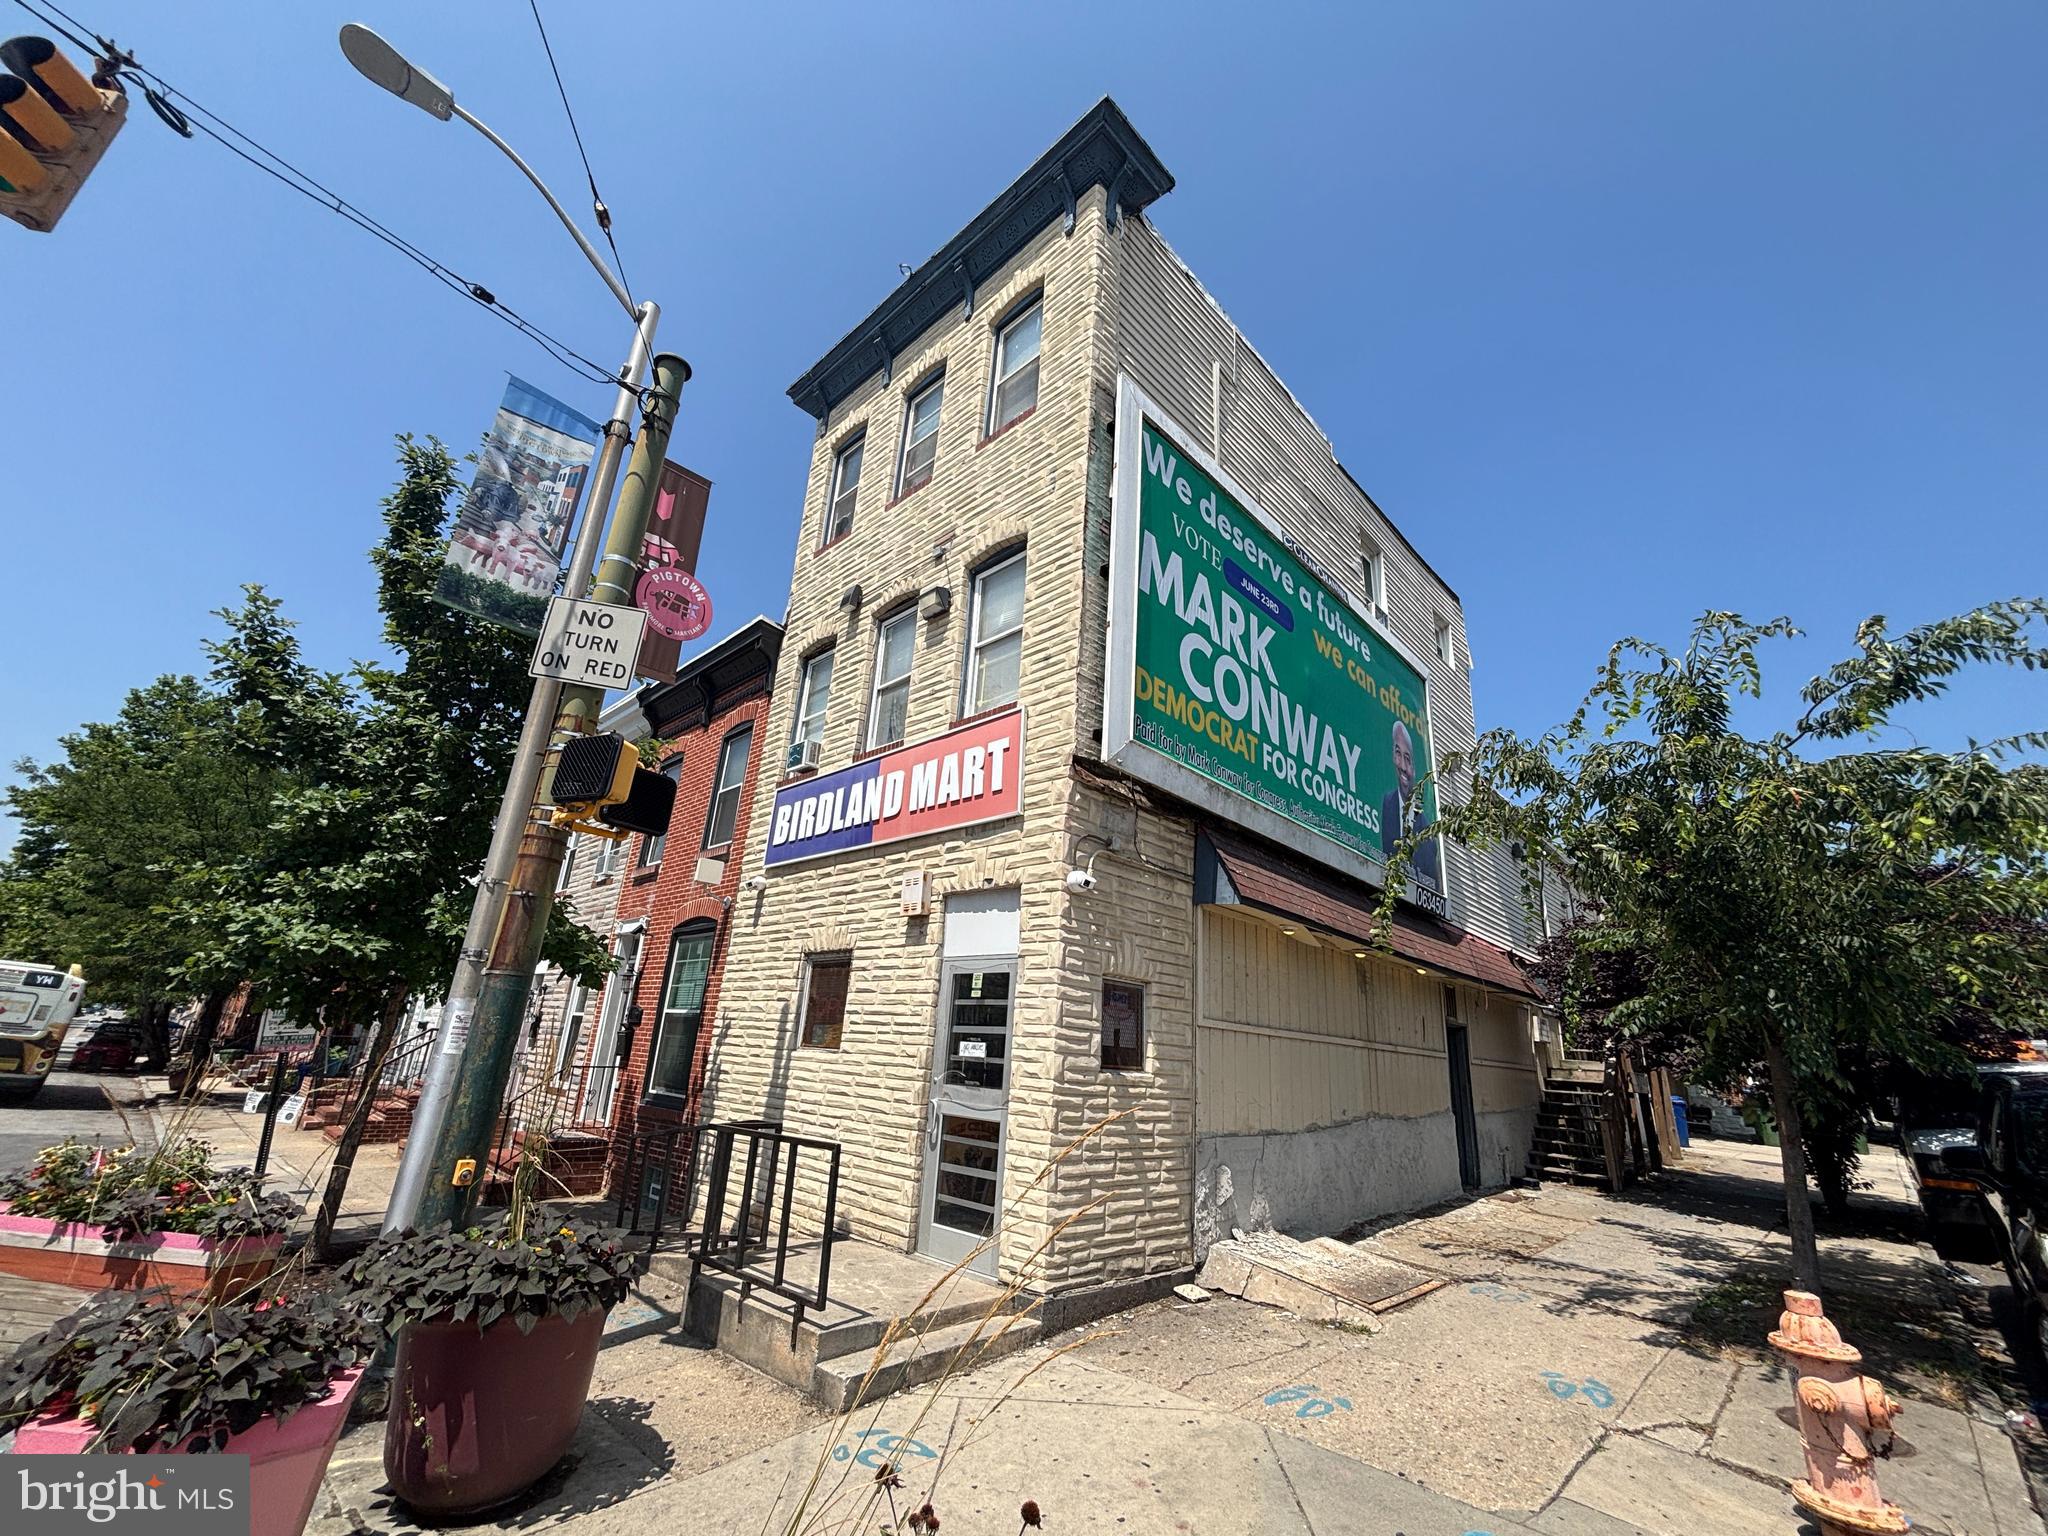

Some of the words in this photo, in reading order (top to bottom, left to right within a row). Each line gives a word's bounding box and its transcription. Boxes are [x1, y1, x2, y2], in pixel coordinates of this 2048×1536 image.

[1142, 431, 1192, 505] We
[1200, 492, 1294, 596] deserve
[1299, 586, 1313, 612] a
[1317, 591, 1371, 662] future
[1171, 511, 1223, 573] VOTE
[651, 571, 706, 601] PIGTOWN
[1139, 530, 1279, 686] MARK
[1240, 578, 1261, 600] JUNE
[1261, 591, 1280, 615] 23RD
[565, 631, 619, 654] TURN
[578, 609, 614, 630] NO
[540, 651, 571, 671] ON
[585, 659, 627, 680] RED
[1313, 628, 1343, 669] we
[1347, 659, 1376, 698] can
[1180, 633, 1361, 792] CONWAY
[1135, 714, 1158, 744] Paid
[1158, 725, 1173, 753] for
[1174, 734, 1187, 764] by
[1188, 743, 1210, 773] Mark
[1212, 756, 1244, 788] Conway
[1136, 665, 1258, 764] DEMOCRAT
[1263, 747, 1298, 789] FOR
[1301, 768, 1380, 834] CONGRESS
[773, 769, 905, 846] BIRDLAND
[909, 737, 1010, 813] MART
[1417, 887, 1445, 916] 063450
